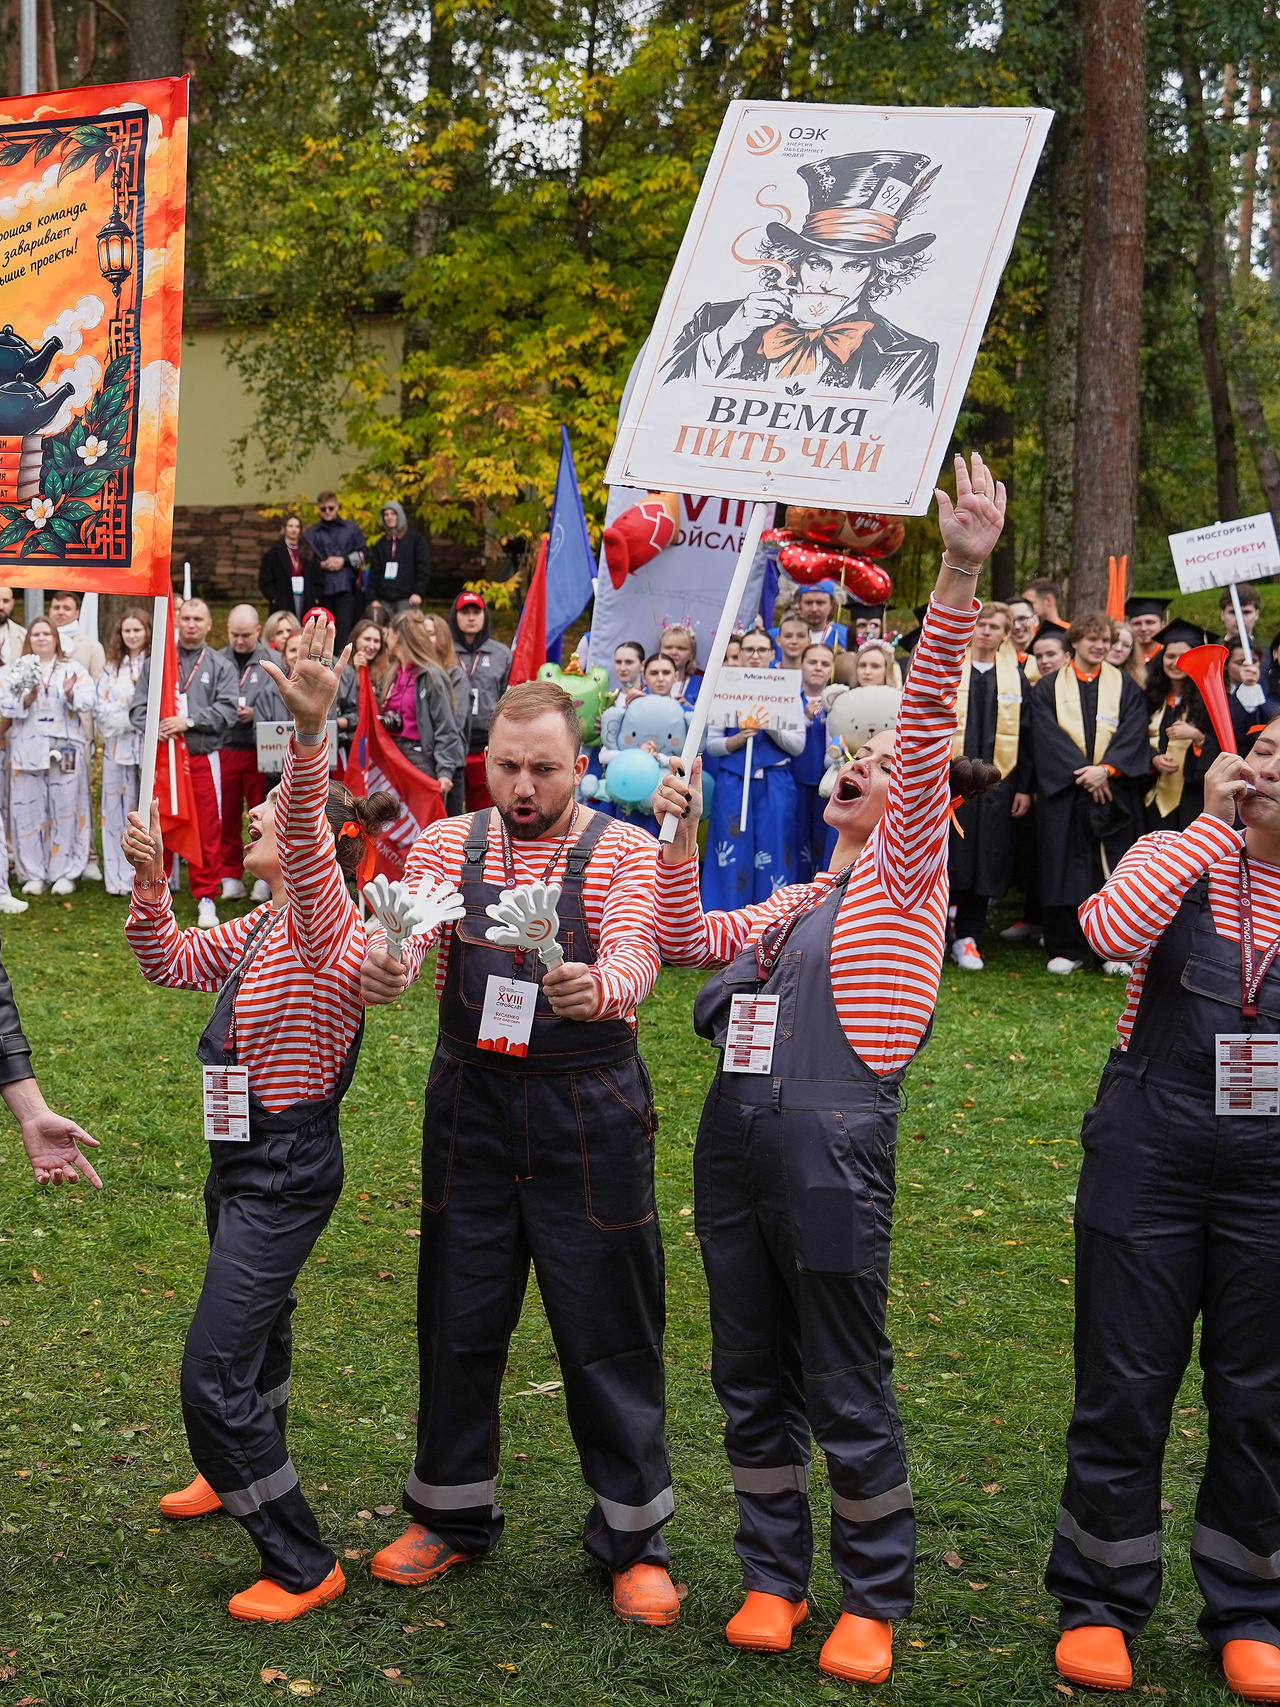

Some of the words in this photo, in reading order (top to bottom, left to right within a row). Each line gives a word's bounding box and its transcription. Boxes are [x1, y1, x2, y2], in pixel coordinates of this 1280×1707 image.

[789, 127, 829, 141] ОЭК
[37, 203, 87, 228] команда
[2, 227, 72, 268] заваривает
[31, 237, 79, 275] проекты!
[706, 395, 870, 436] ВРЕМЯ
[672, 425, 786, 464] ПИТЬ
[801, 434, 886, 473] ЧАЙ
[1197, 522, 1256, 542] МОСГОРБТИ
[1185, 541, 1266, 566] МОСГОРБТИ
[713, 693, 796, 704] МОНАРХ-ПРОЕКТ
[497, 992, 523, 1006] XVIII
[1247, 974, 1260, 1003] ГОРОДА
